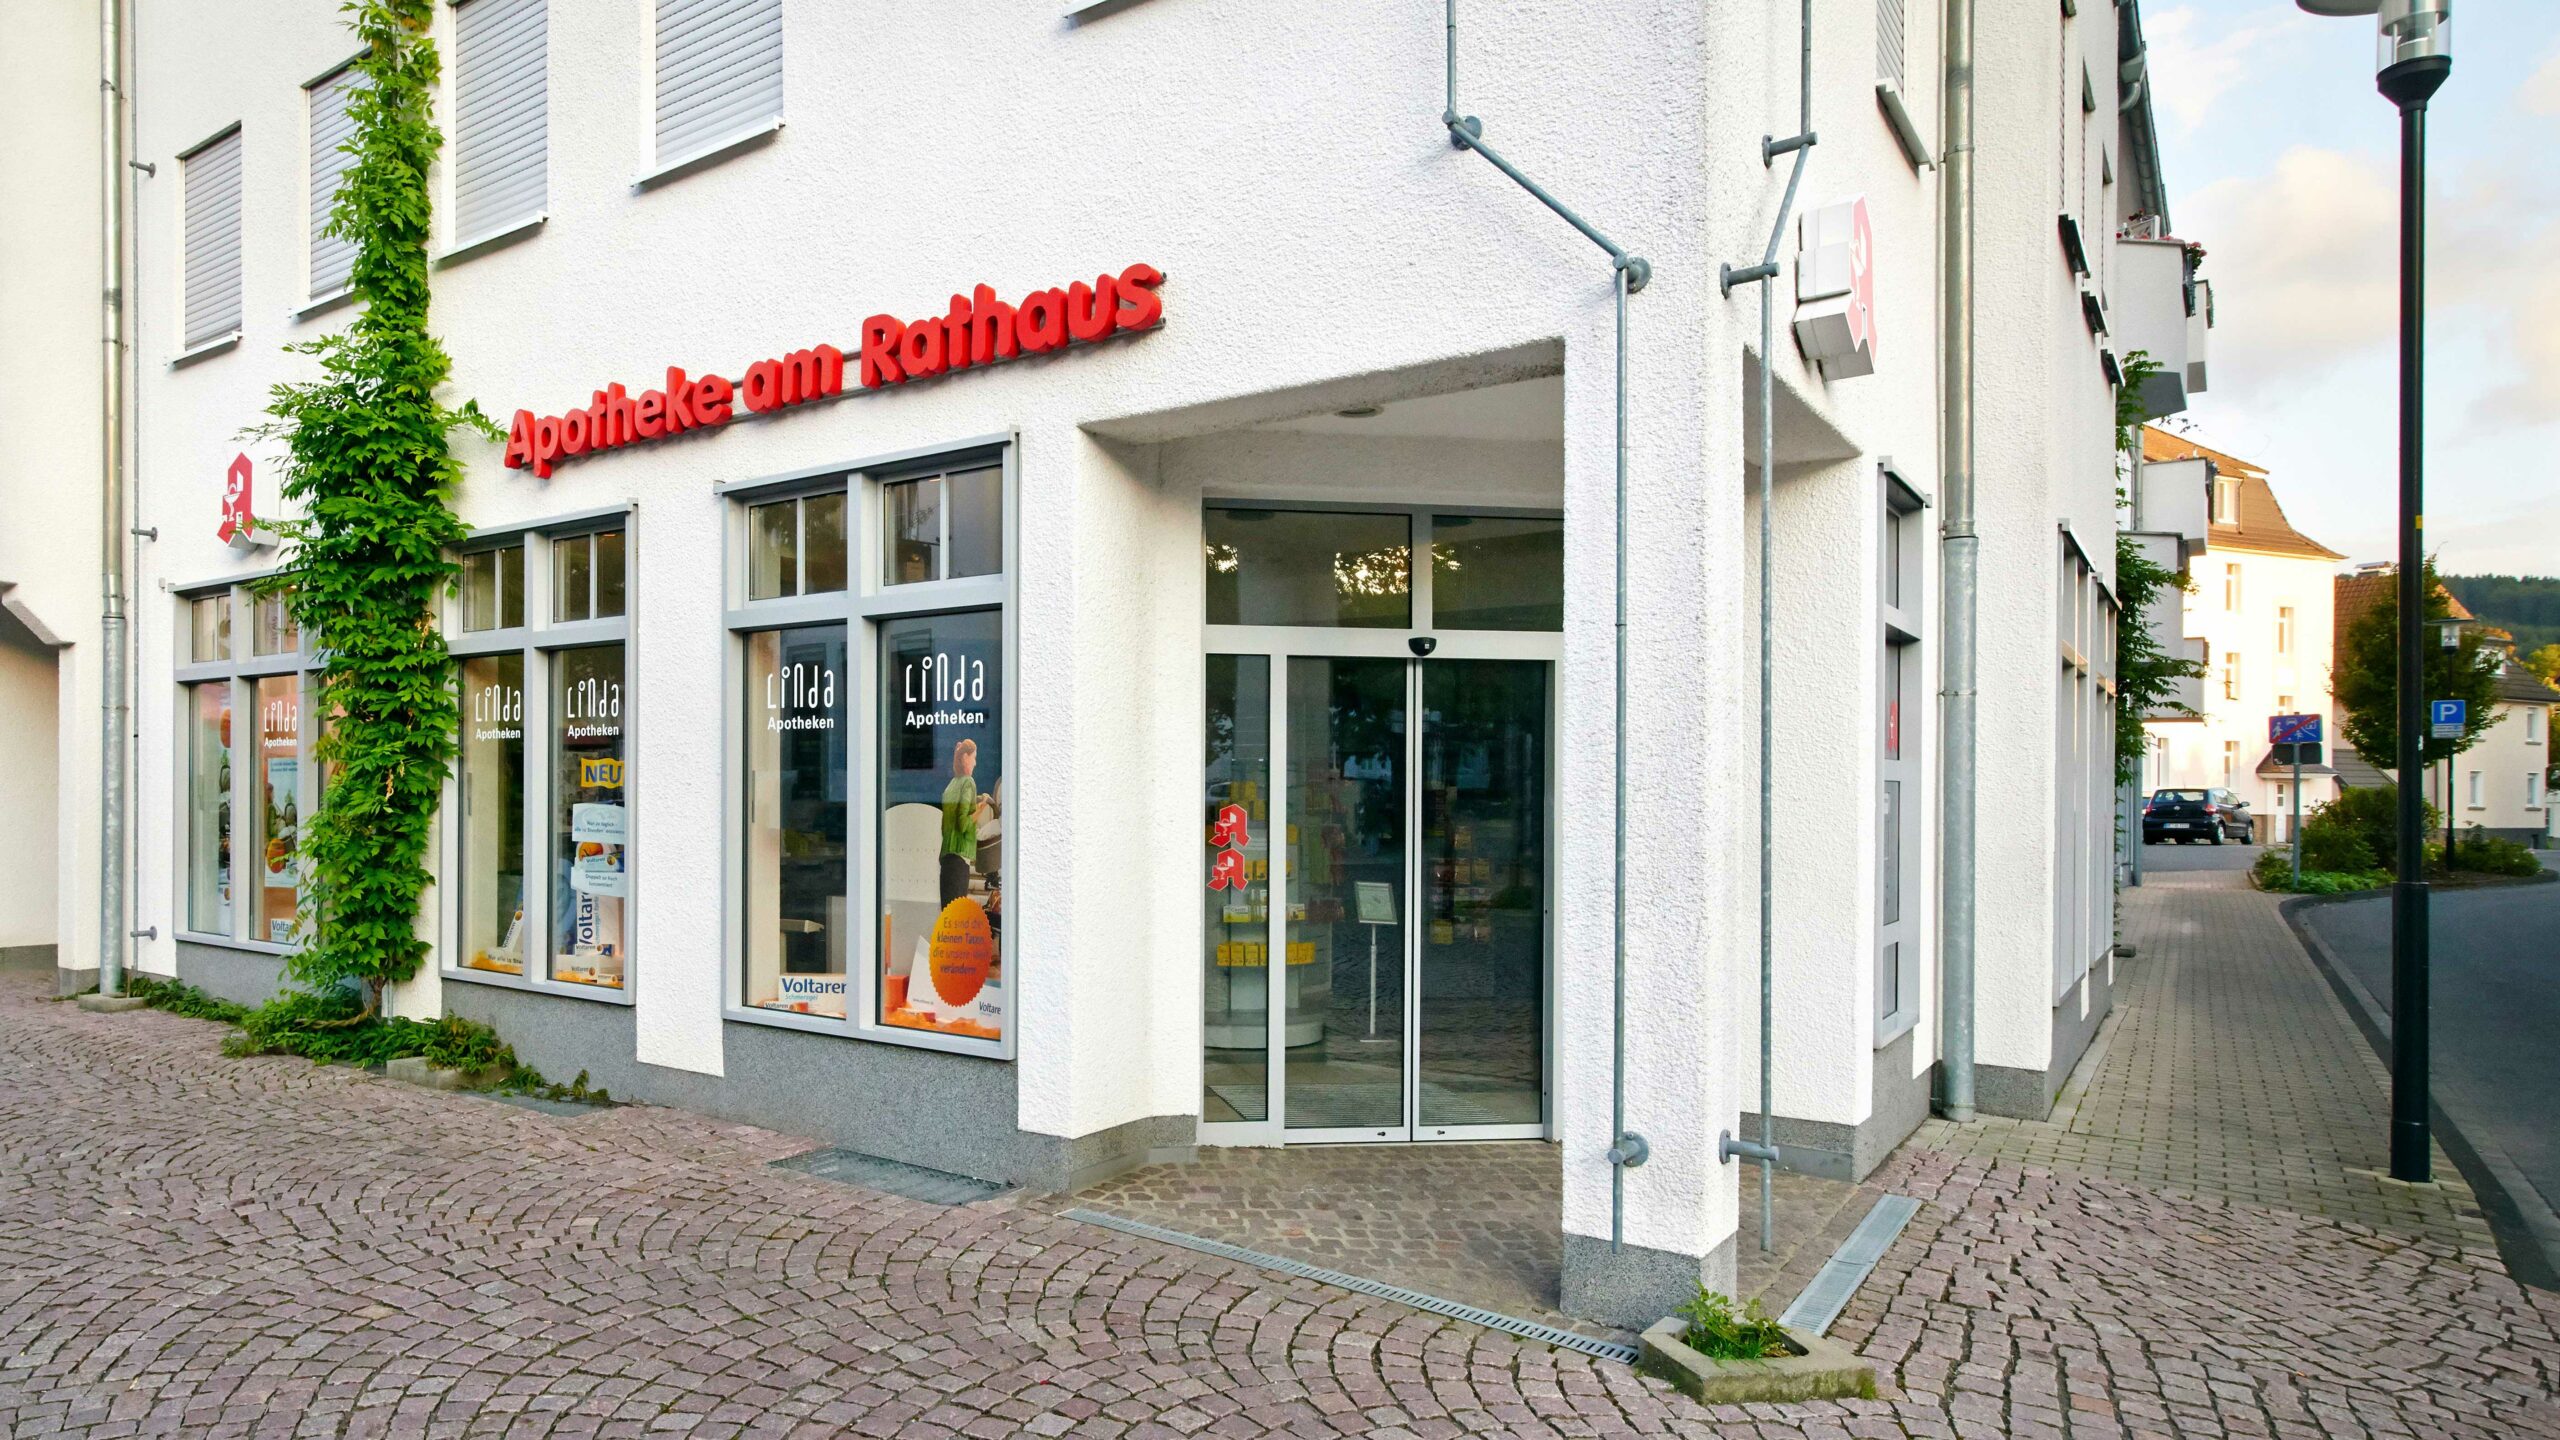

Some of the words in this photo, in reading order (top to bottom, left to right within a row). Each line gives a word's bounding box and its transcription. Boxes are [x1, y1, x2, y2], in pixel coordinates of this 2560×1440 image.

[504, 366, 733, 479] Apotheke
[743, 343, 844, 414] am
[861, 263, 1164, 389] Rathaus
[905, 708, 984, 729] Apotheken
[2440, 703, 2457, 721] P
[567, 723, 619, 739] Apotheken
[767, 714, 834, 733] Apotheken
[264, 737, 297, 748] Apotheken
[475, 727, 521, 742] Apotheken
[585, 764, 622, 784] NEU
